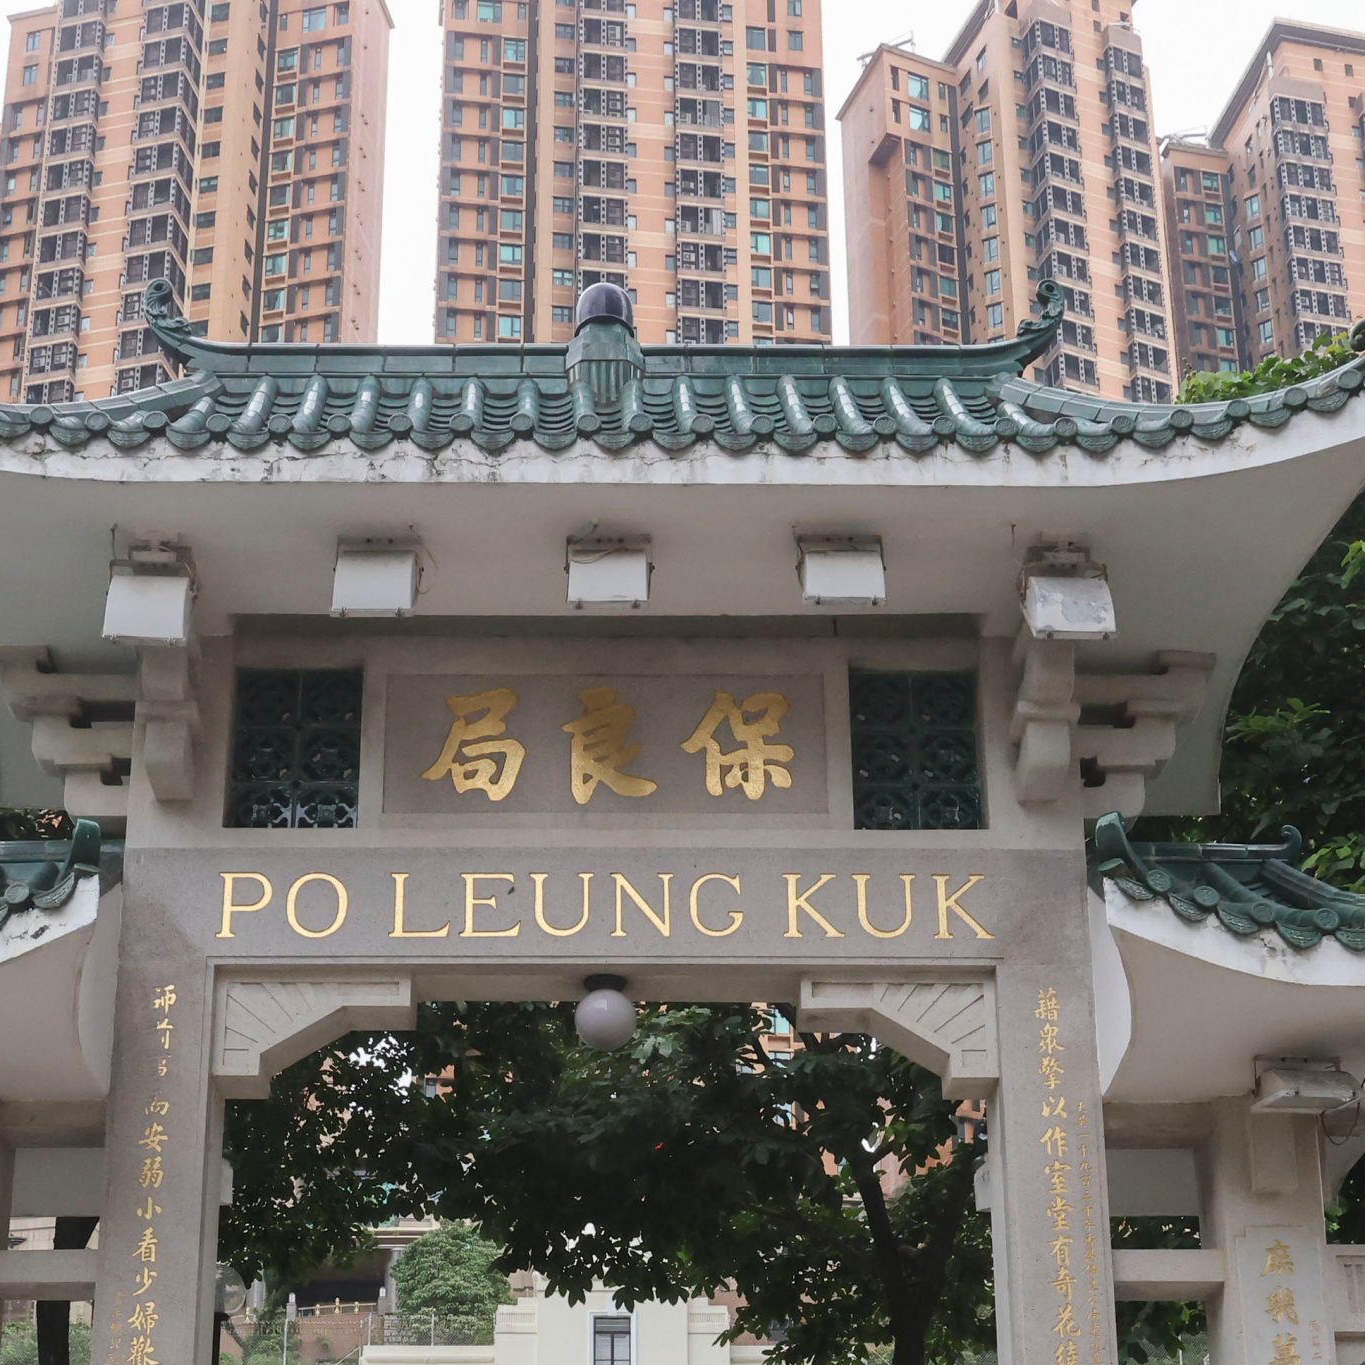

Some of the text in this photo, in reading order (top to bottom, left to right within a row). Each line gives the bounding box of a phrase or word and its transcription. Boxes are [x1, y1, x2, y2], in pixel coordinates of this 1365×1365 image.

[421, 687, 795, 805] 保良局
[216, 871, 995, 940] PO LEUNG KUK
